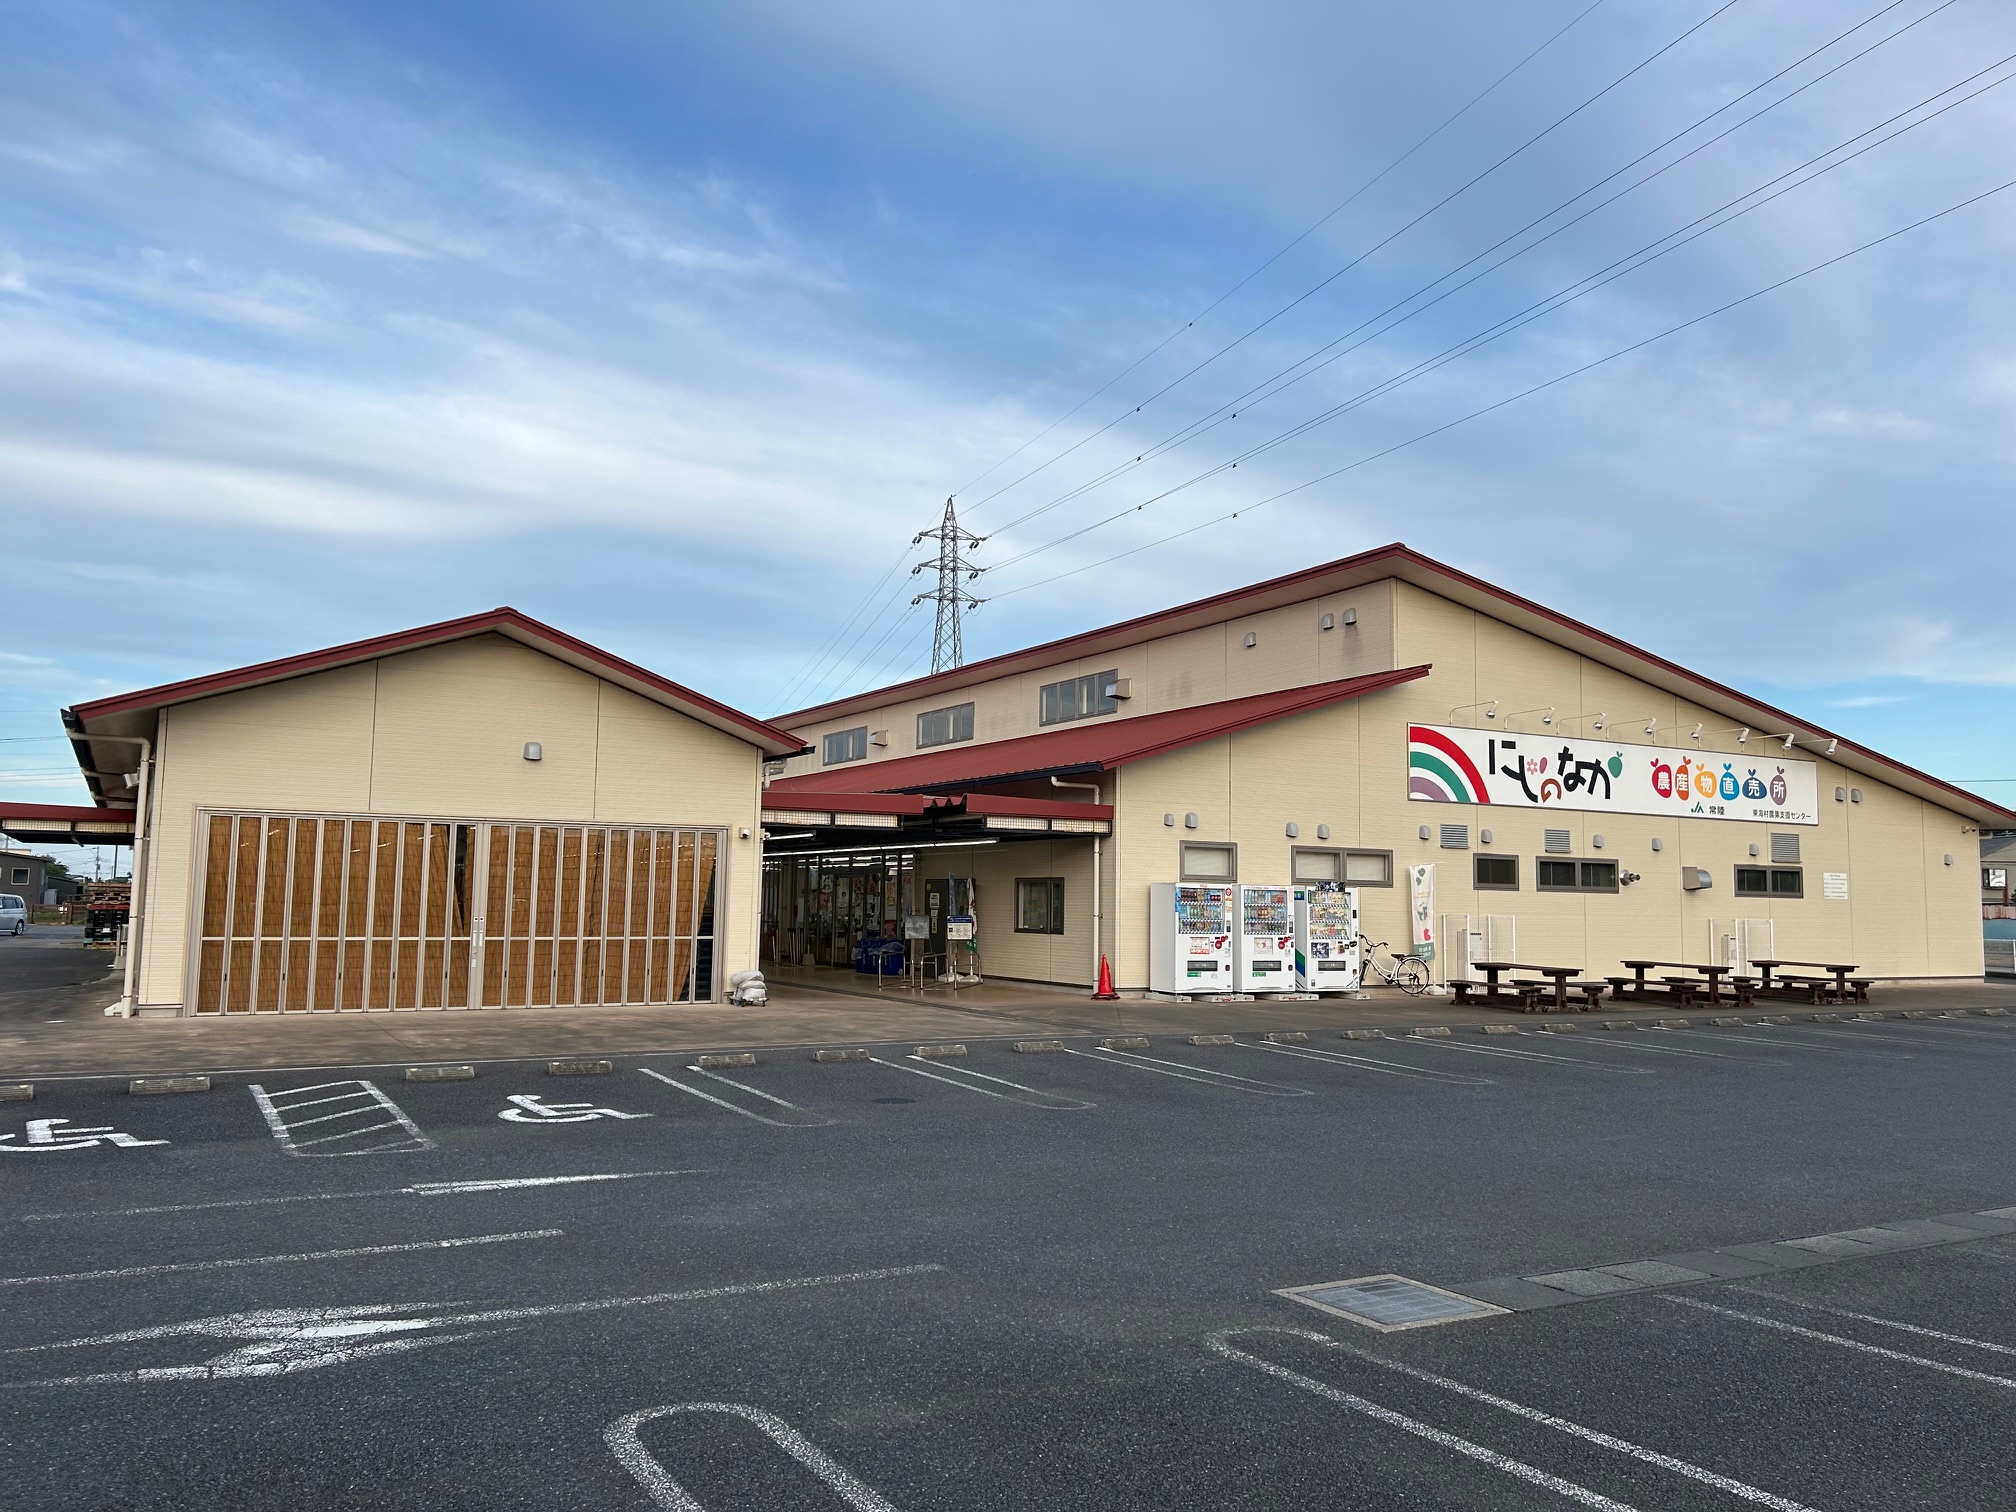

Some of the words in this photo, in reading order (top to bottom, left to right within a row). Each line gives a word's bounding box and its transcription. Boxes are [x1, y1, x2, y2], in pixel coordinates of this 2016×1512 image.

[1657, 771, 1785, 799] 農産物直売所
[1691, 801, 1704, 814] JA
[1709, 805, 1725, 816] 常陸
